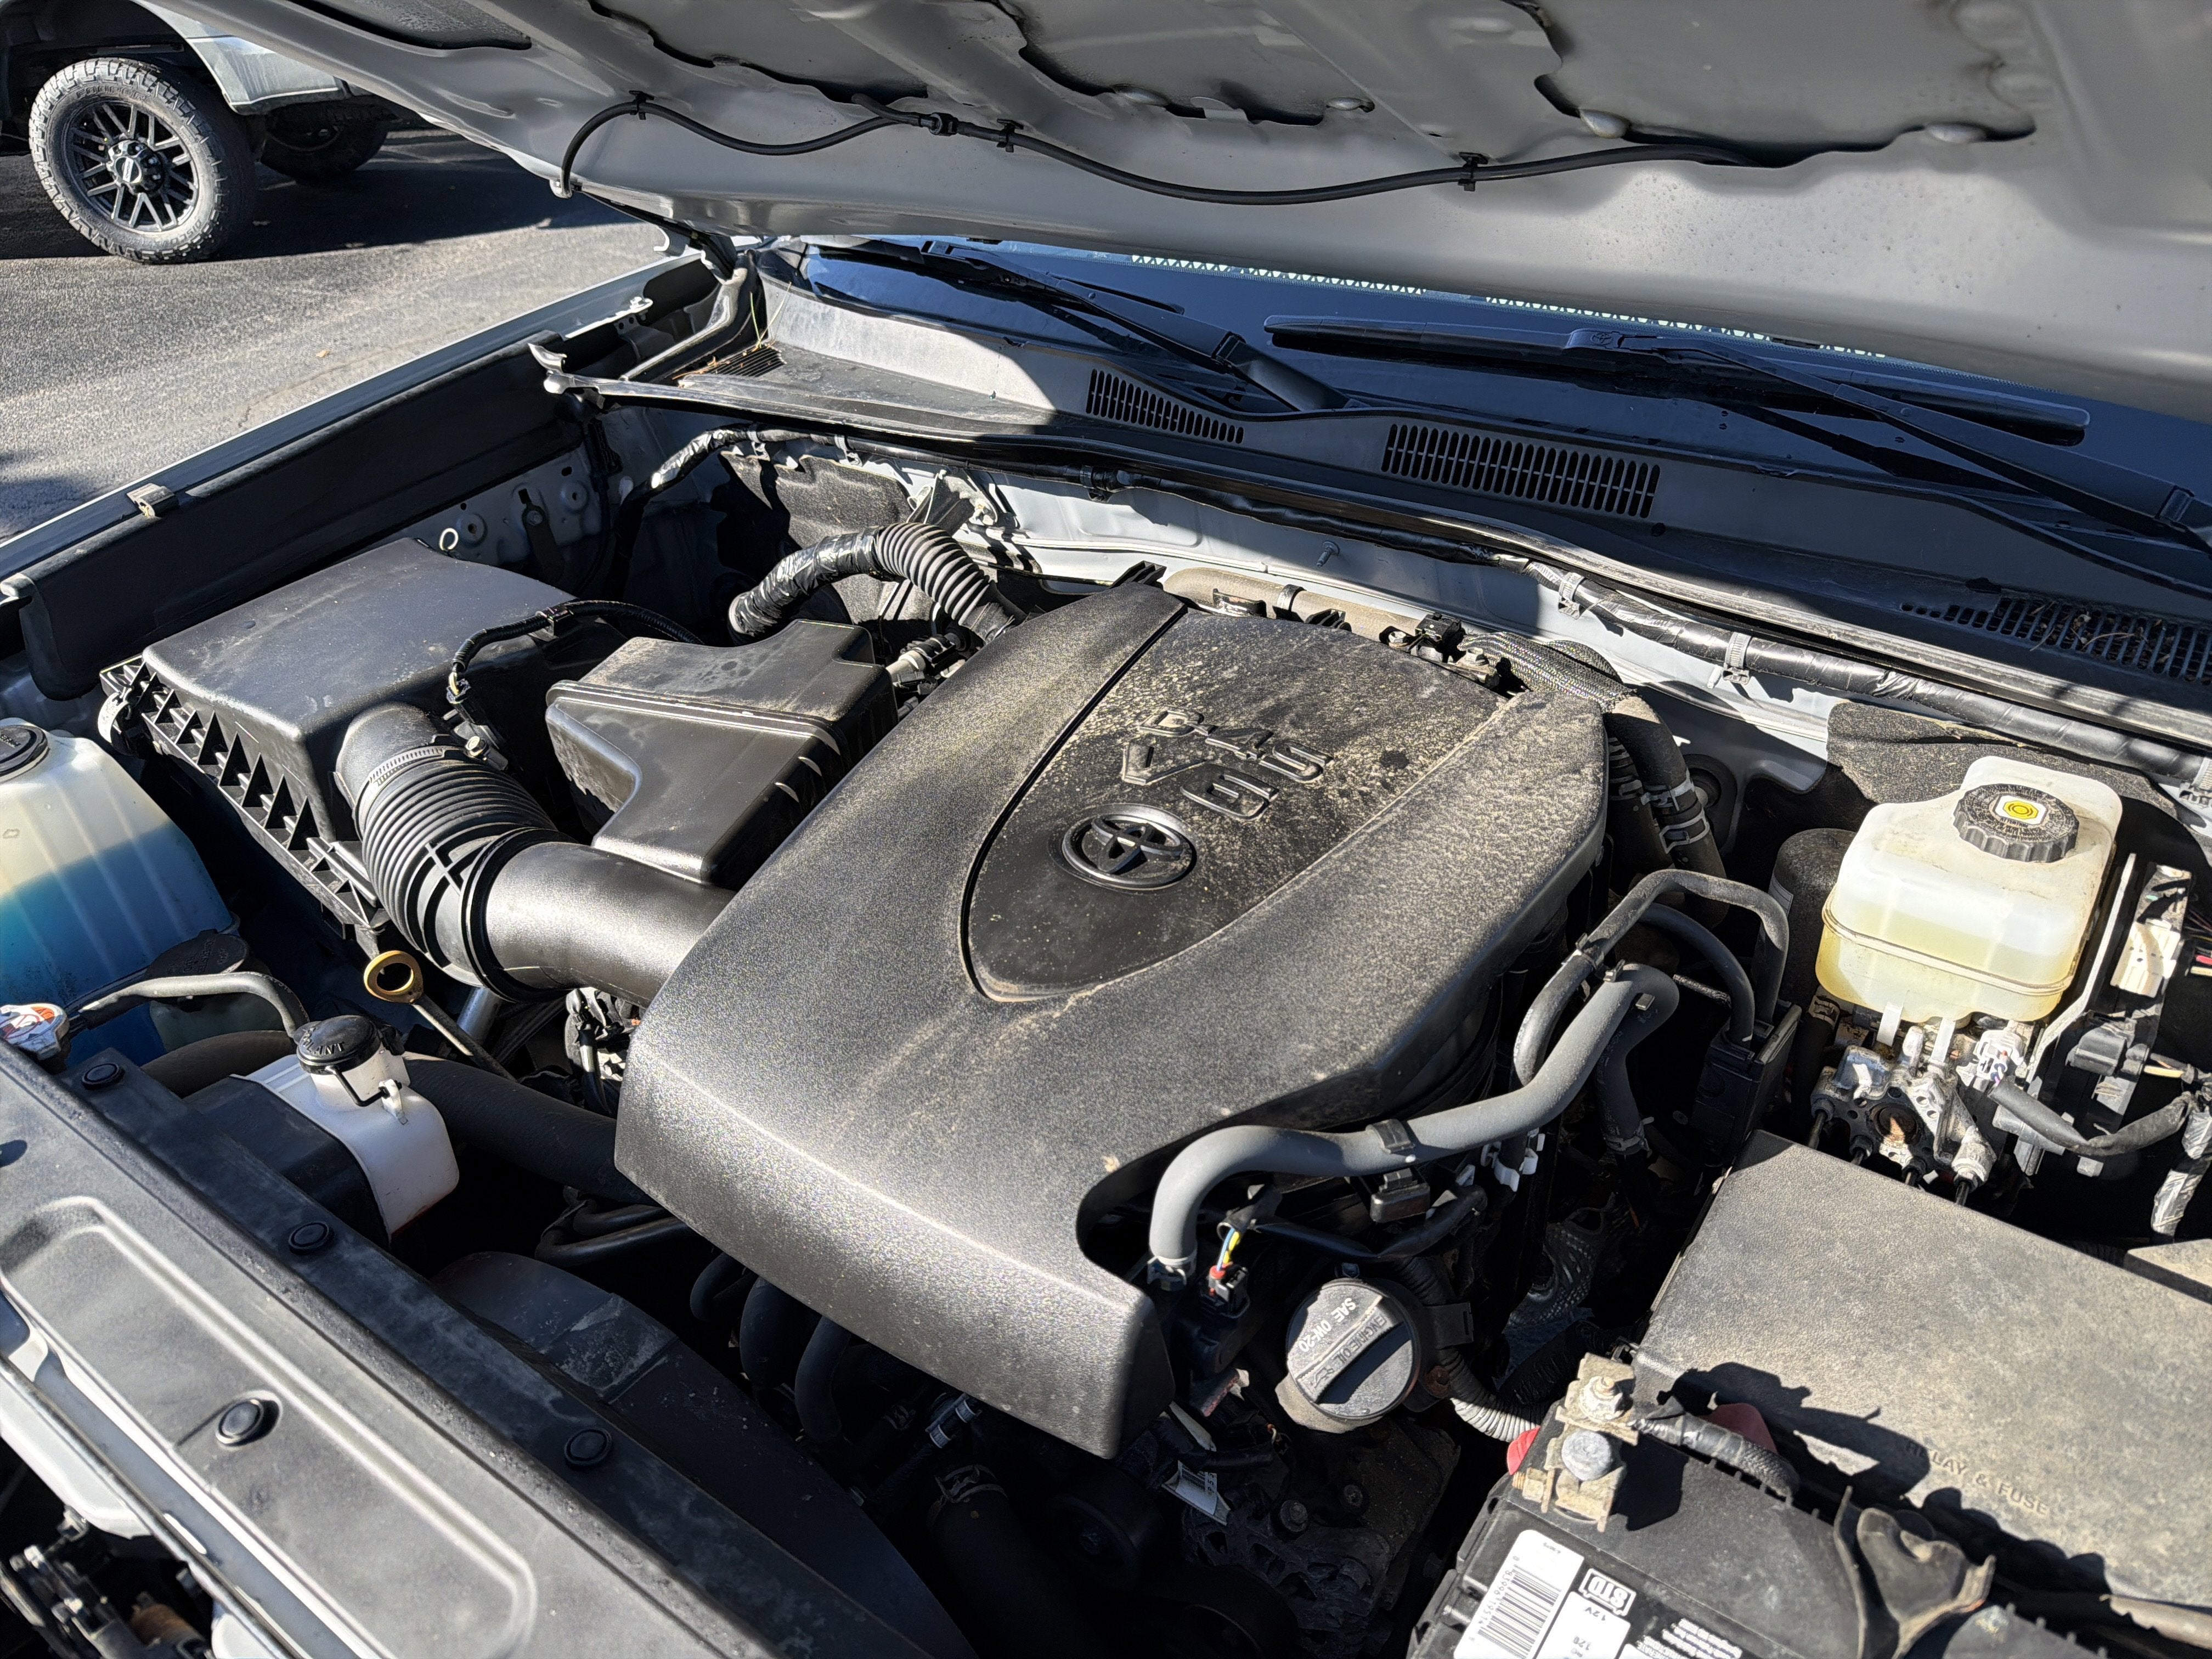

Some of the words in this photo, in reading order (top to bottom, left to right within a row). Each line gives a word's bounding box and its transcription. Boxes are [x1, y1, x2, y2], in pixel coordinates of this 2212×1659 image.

[1122, 741, 1280, 820] V6
[1331, 1297, 1357, 1323] SAE
[1348, 1313, 1387, 1353] ENGINE
[1332, 1347, 1352, 1364] OIL
[1975, 1474, 1989, 1488] &
[1997, 1482, 2049, 1516] FUSE
[1588, 1576, 1628, 1609] STD
[1584, 1606, 1606, 1621] 12V
[1573, 1636, 1591, 1651] 120
